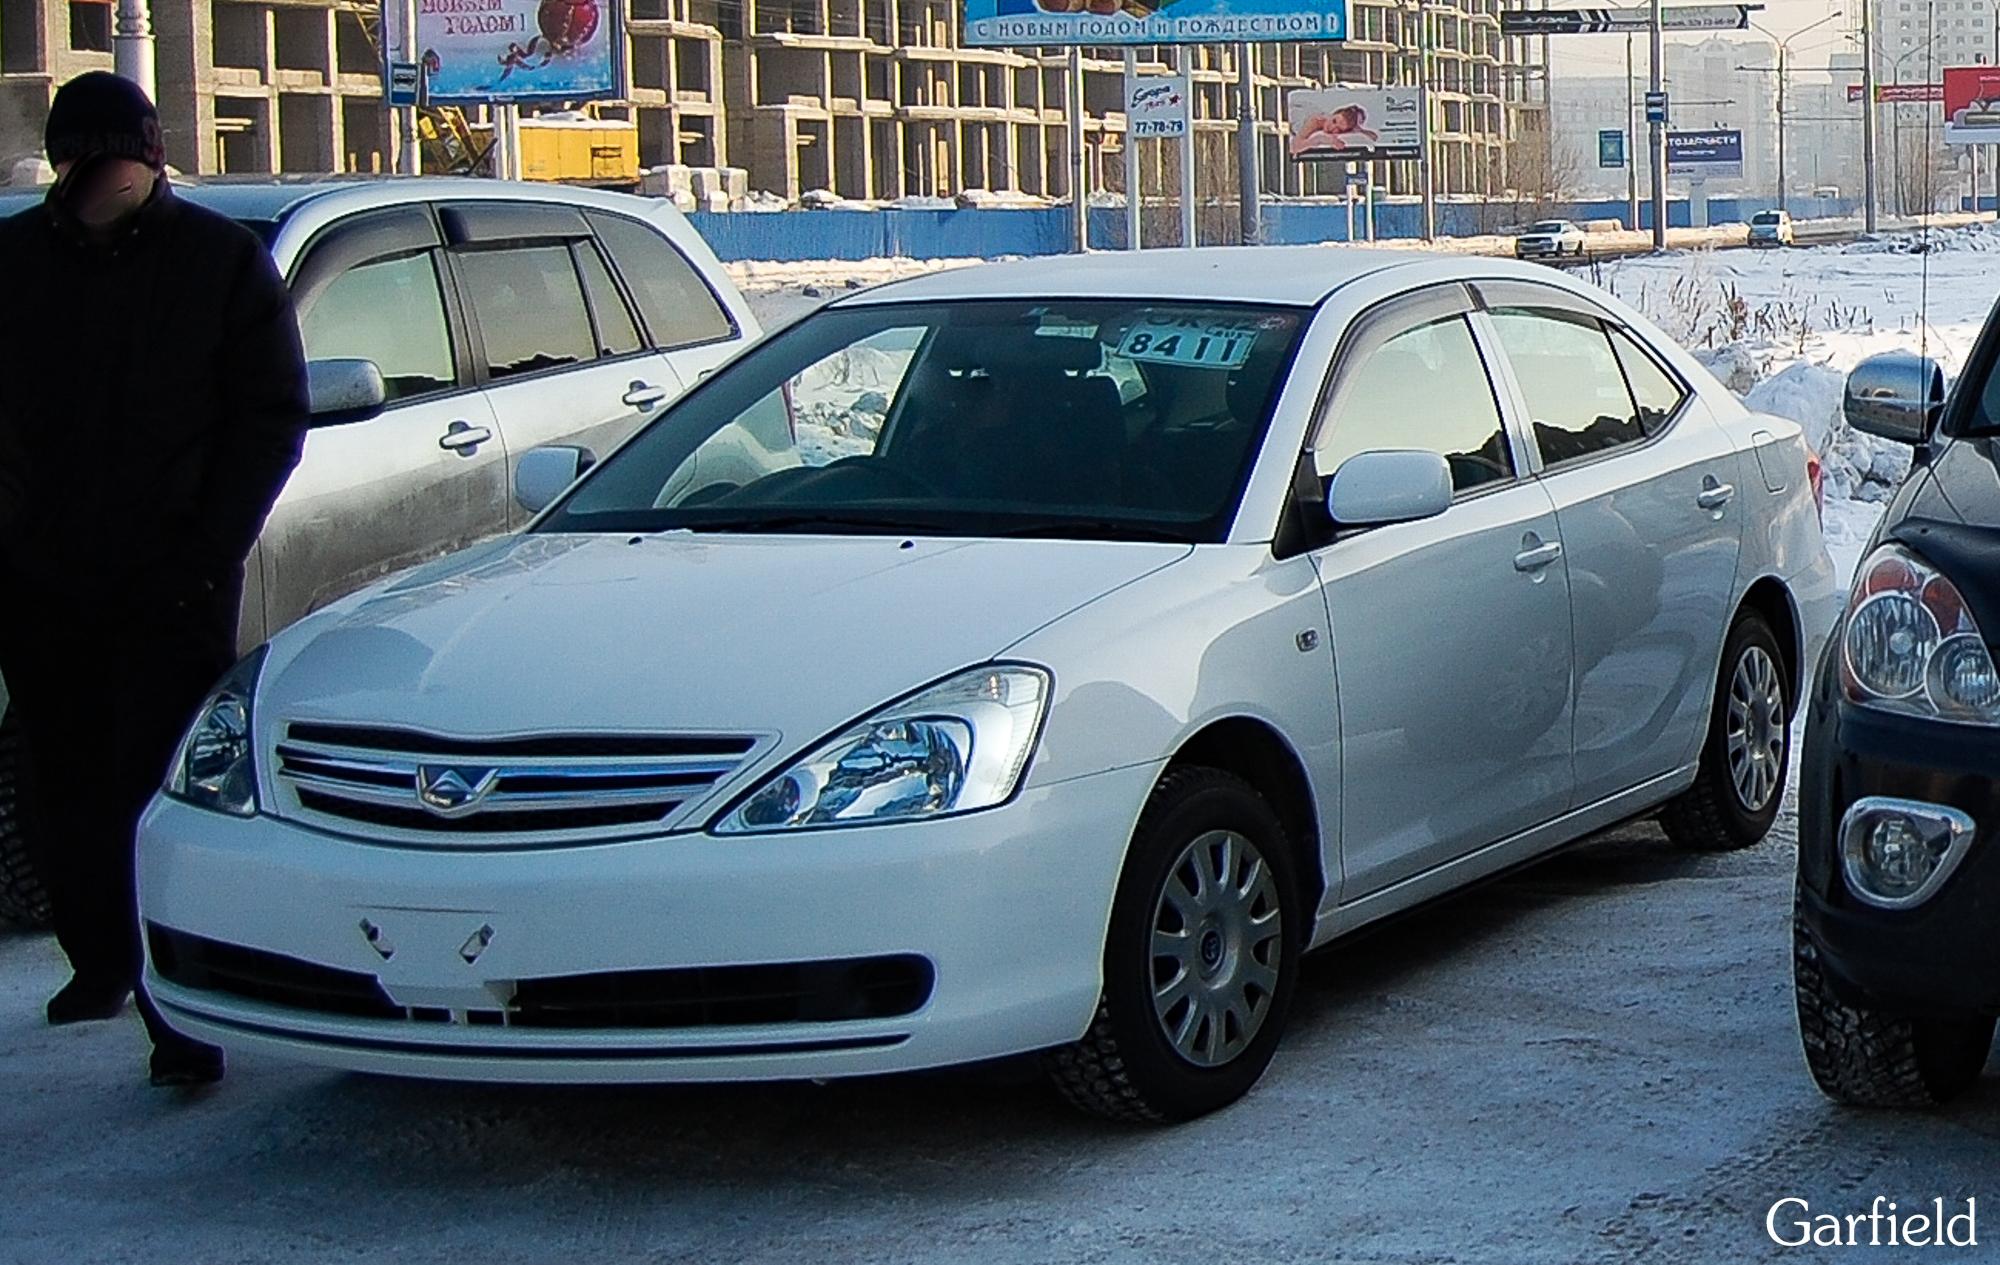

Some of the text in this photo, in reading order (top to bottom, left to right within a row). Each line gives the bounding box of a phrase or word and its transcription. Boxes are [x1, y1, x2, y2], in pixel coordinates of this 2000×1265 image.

[977, 23, 988, 36] С
[999, 22, 1068, 37] НОВЫМ
[1079, 20, 1147, 36] ГОДОМ
[1135, 120, 1183, 134] 77-78-79
